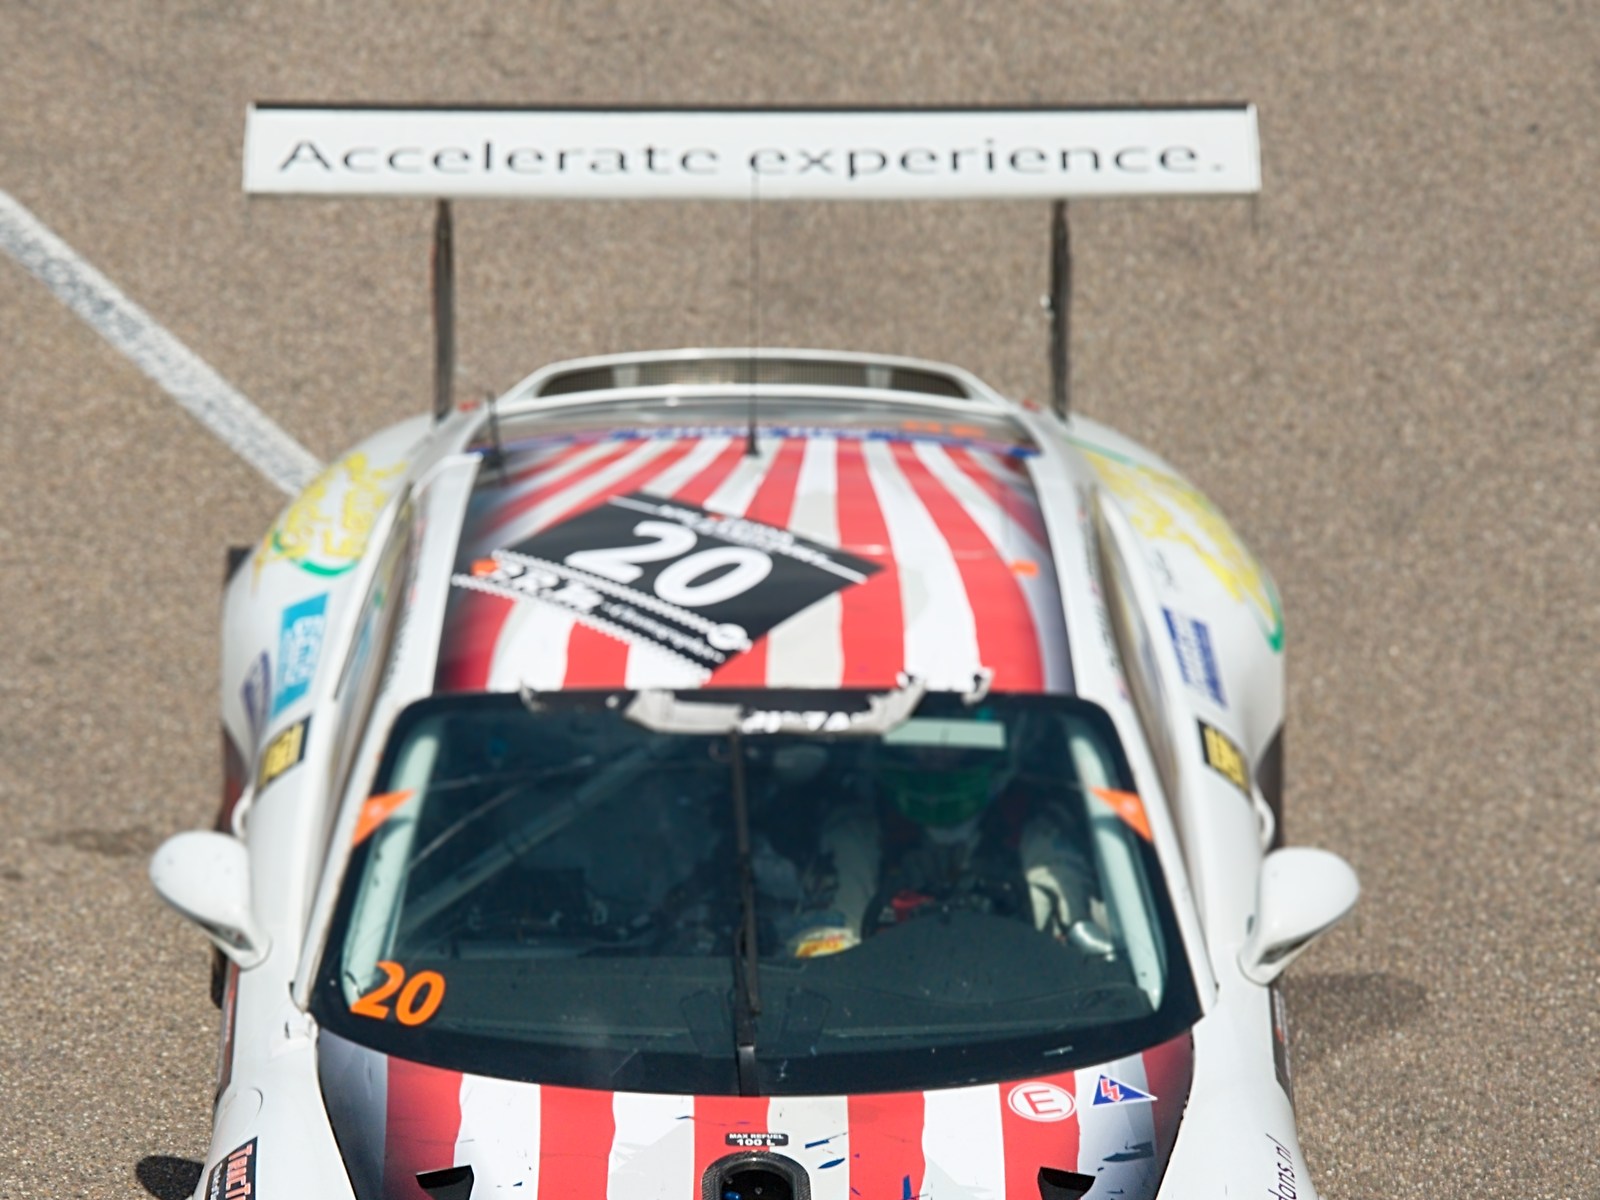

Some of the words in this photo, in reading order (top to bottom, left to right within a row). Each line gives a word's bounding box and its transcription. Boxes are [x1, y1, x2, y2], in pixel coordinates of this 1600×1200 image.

[280, 140, 720, 173] Accelerate
[749, 139, 1224, 179] experience.
[565, 520, 772, 607] 20
[350, 960, 446, 1025] 20
[1022, 1089, 1063, 1114] E
